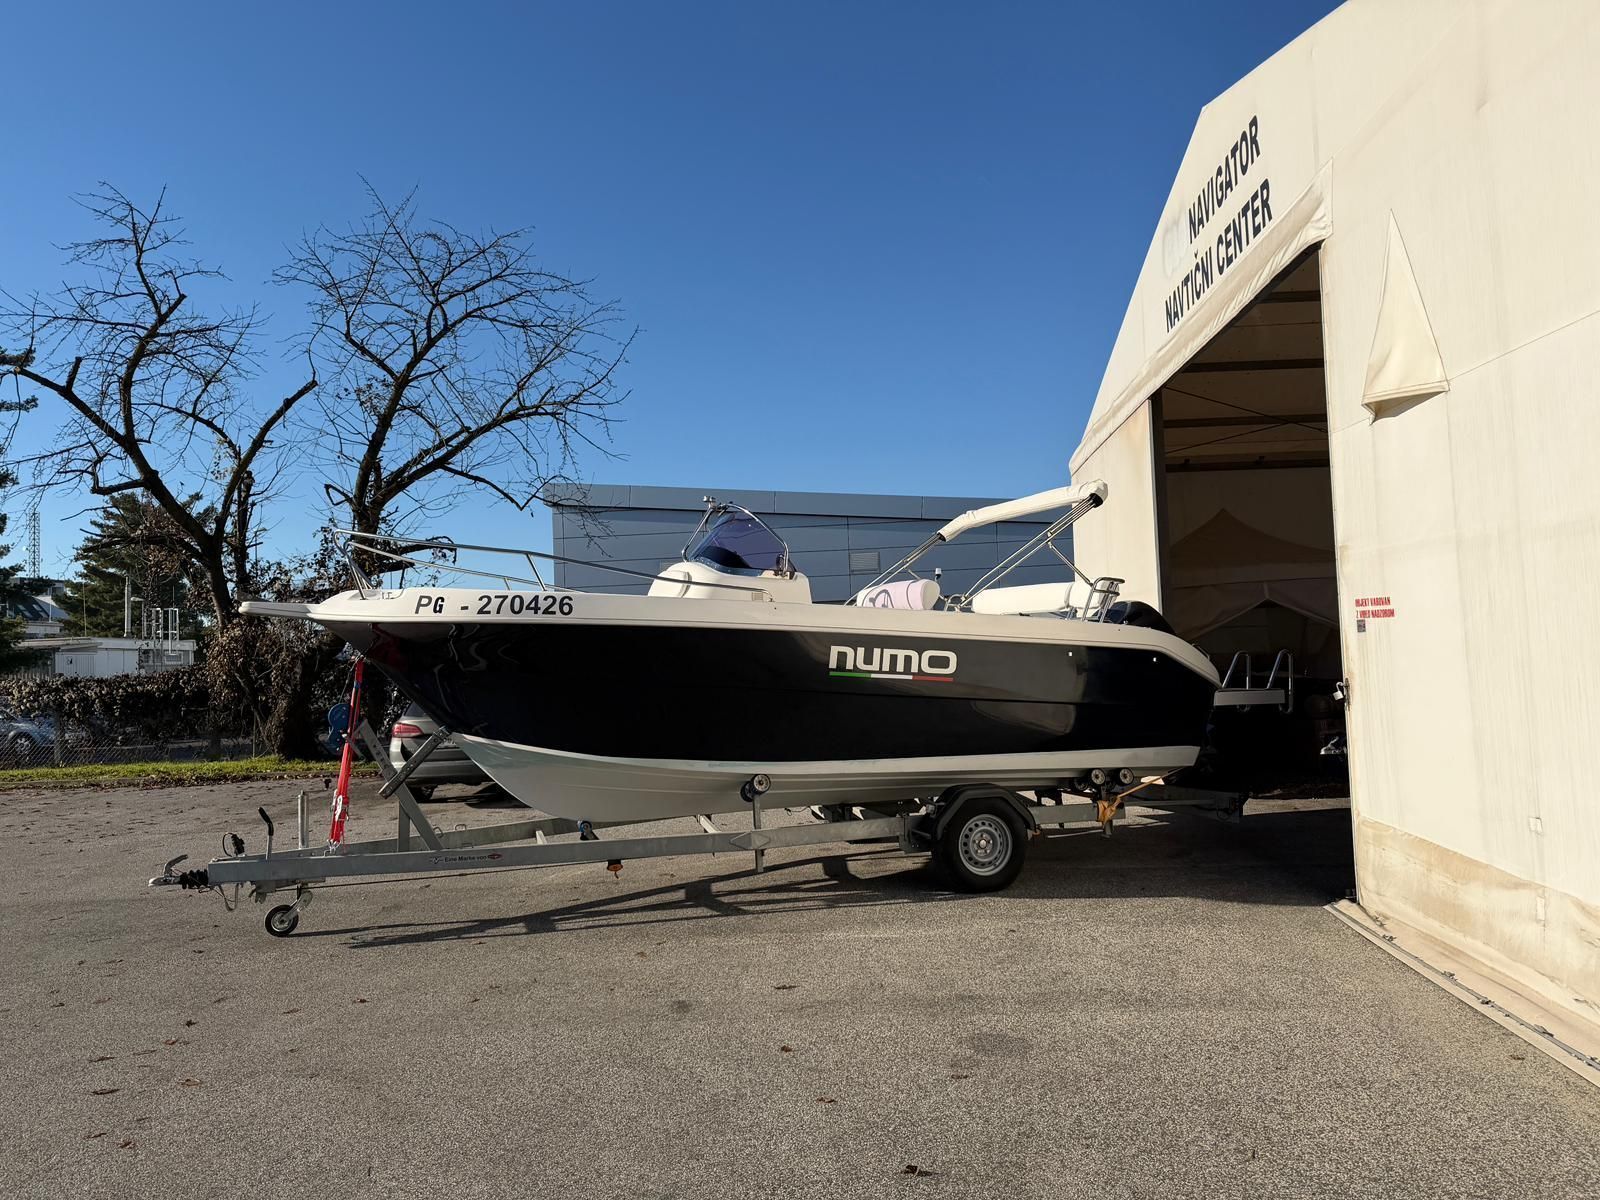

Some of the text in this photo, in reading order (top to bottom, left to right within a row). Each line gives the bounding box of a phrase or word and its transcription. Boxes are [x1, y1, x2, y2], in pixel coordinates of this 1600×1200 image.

[1188, 115, 1261, 244] NAVIGATOR
[1165, 178, 1273, 333] NAVTIČNI CENTER
[415, 595, 445, 614] PG
[476, 595, 574, 616] 270426
[829, 645, 958, 675] numo
